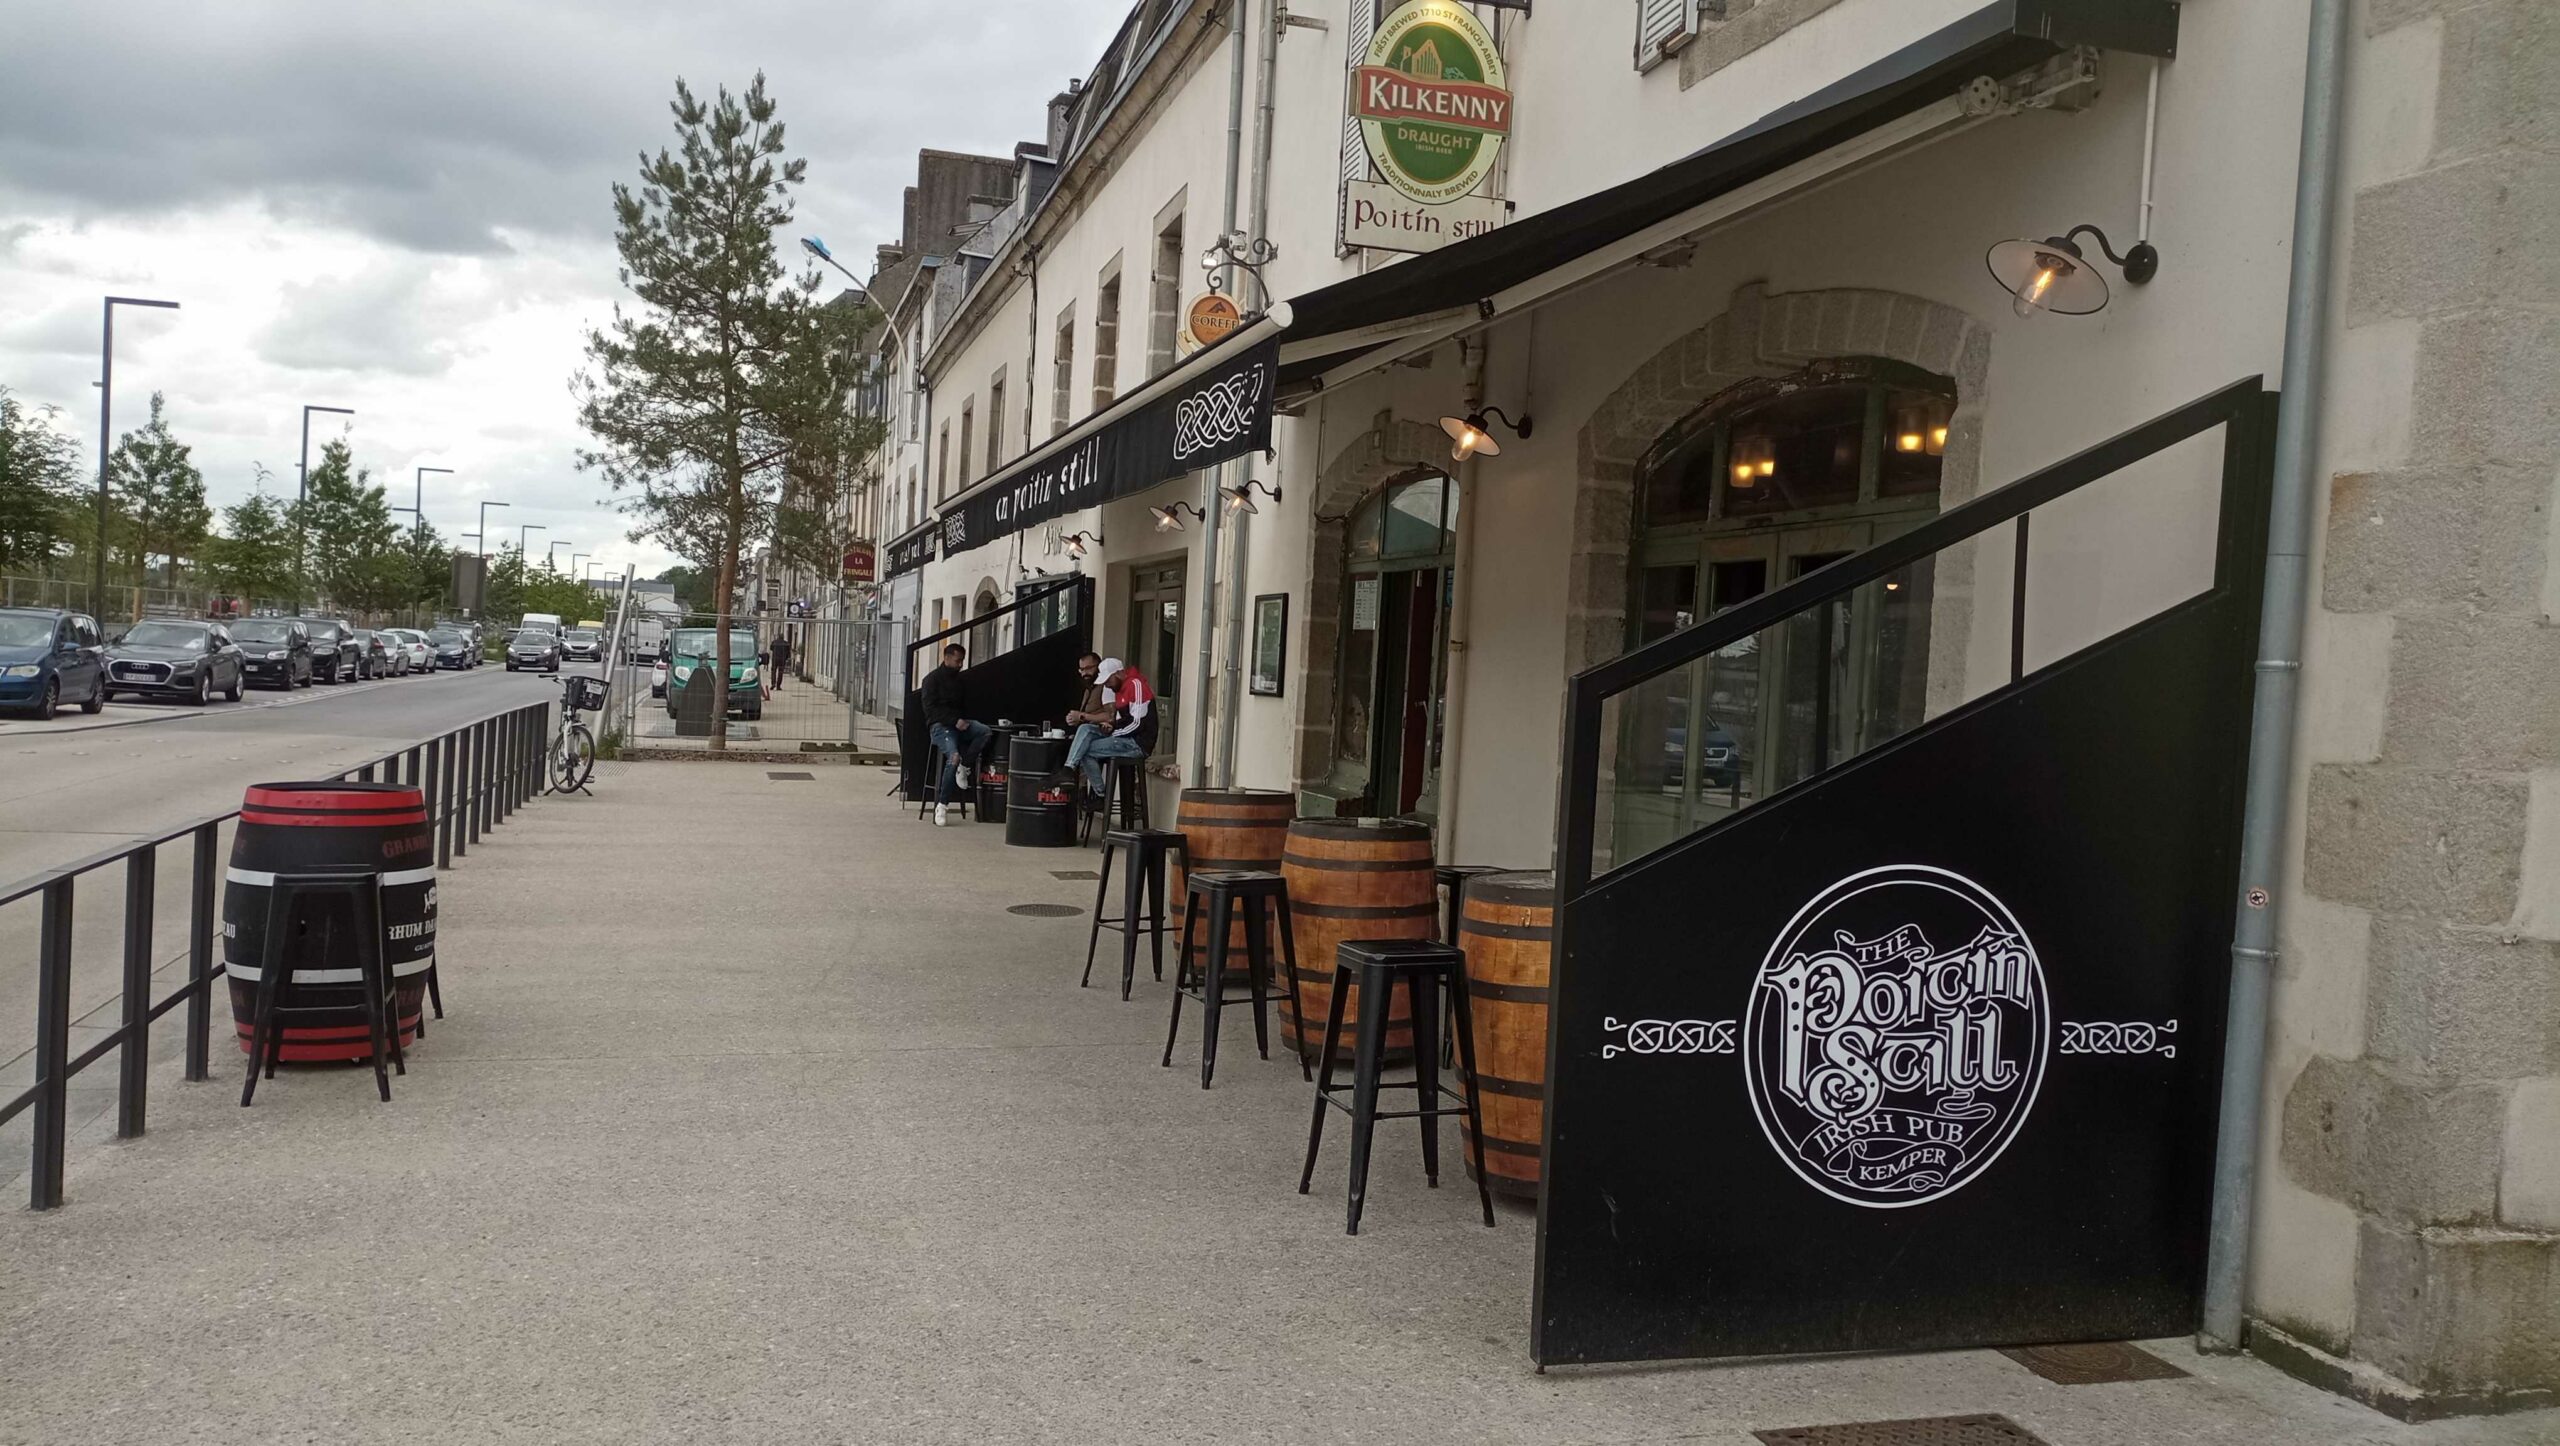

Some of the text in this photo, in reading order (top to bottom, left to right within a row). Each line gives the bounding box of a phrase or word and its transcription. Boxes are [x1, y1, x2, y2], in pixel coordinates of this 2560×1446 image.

[1374, 8, 1498, 76] FIRST BREWED 1710 ST FRANCIS ABBEY
[1368, 75, 1506, 123] KILKENNY
[1398, 127, 1473, 149] DRAUGHT
[1415, 143, 1453, 155] IRISH BEER
[1444, 170, 1478, 196] BREWED
[1060, 436, 1100, 495] still
[854, 557, 863, 565] LA
[1857, 929, 1911, 961] THE
[1814, 1113, 1964, 1155] IRISH PUB
[1859, 1148, 1947, 1181] KEMPER
